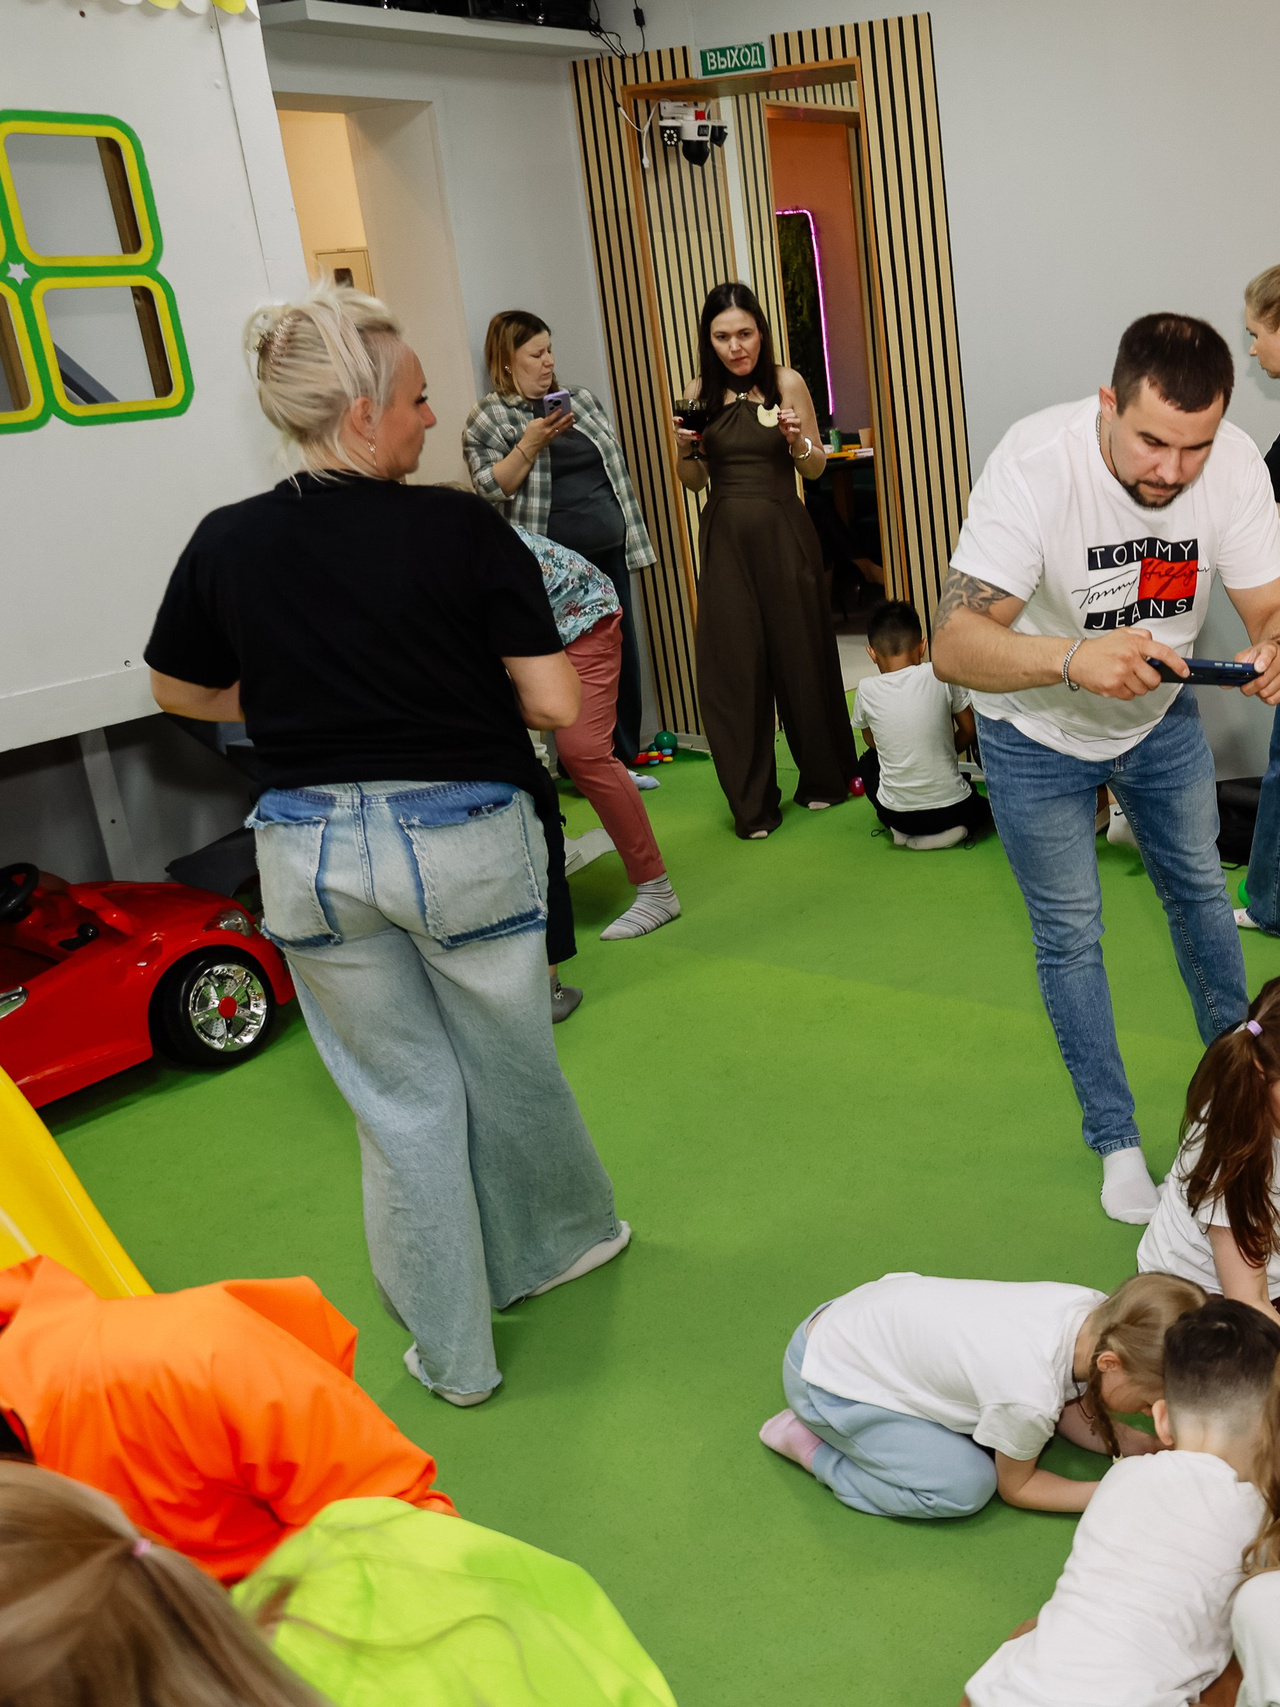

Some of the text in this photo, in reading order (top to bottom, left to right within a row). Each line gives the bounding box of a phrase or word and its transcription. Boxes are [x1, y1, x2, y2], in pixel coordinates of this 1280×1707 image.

[706, 45, 762, 71] ВЫХОД
[1091, 540, 1194, 569] TOMMY
[1071, 569, 1138, 609] Tommy
[1092, 598, 1187, 629] JEANS
